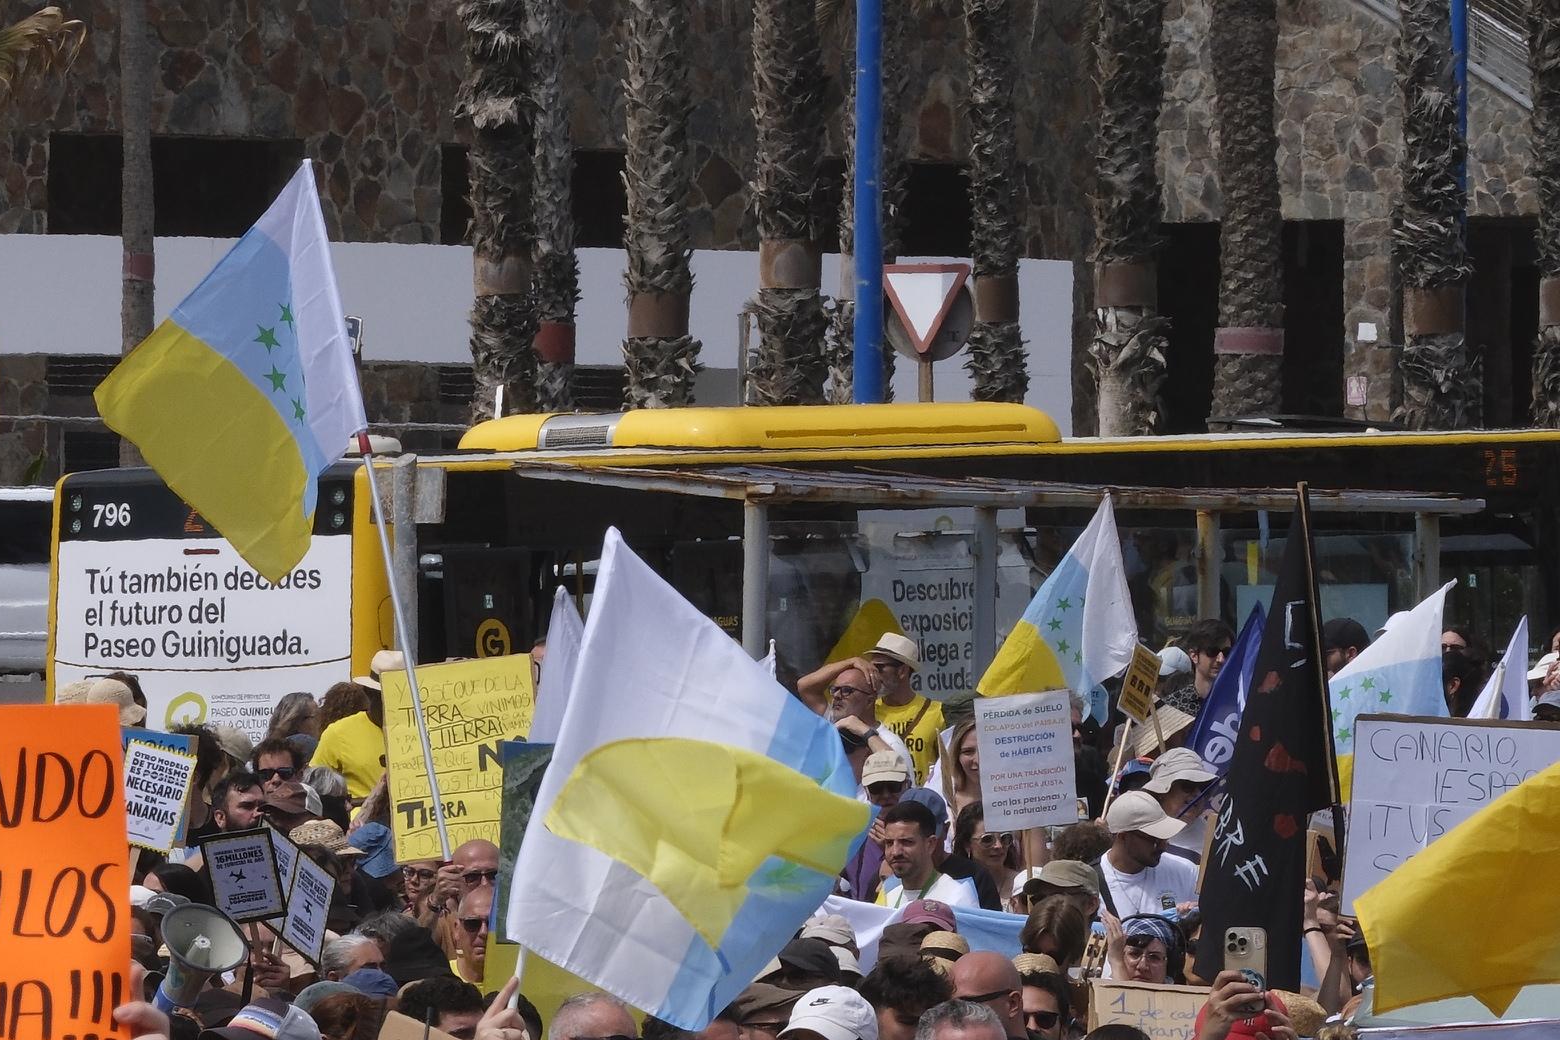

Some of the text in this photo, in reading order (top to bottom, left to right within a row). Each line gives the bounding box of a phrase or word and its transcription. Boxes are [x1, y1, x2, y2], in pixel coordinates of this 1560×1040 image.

[92, 502, 131, 528] 796
[85, 563, 321, 594] Tú también decdes
[85, 597, 225, 626] el futuro del
[85, 629, 309, 663] Paseo Guiniguada.
[211, 706, 275, 717] PASEO GUINIGU
[1022, 708, 1032, 716] de
[1034, 703, 1063, 714] SUELO
[235, 719, 269, 729] CULTUR
[440, 719, 500, 749] TIERRA
[994, 731, 1056, 746] DESTRUCCIÓN
[1370, 728, 1519, 768] CANARIO,
[135, 751, 190, 772] OTRO MODELO
[1000, 744, 1053, 759] de HÁBITATS
[130, 765, 141, 776] ES
[132, 757, 188, 779] DE TURISMO
[990, 773, 1006, 781] POR
[1007, 771, 1023, 779] UNA
[126, 775, 183, 801] NECESARIO
[1040, 779, 1064, 788] JUSTA
[143, 795, 157, 805] EN
[991, 800, 1008, 808] con
[1023, 793, 1061, 806] personas
[1013, 804, 1058, 816] naturaleza
[126, 800, 177, 826] ANARIAS
[397, 800, 468, 830] TIERRA
[12, 861, 119, 946] LOS
